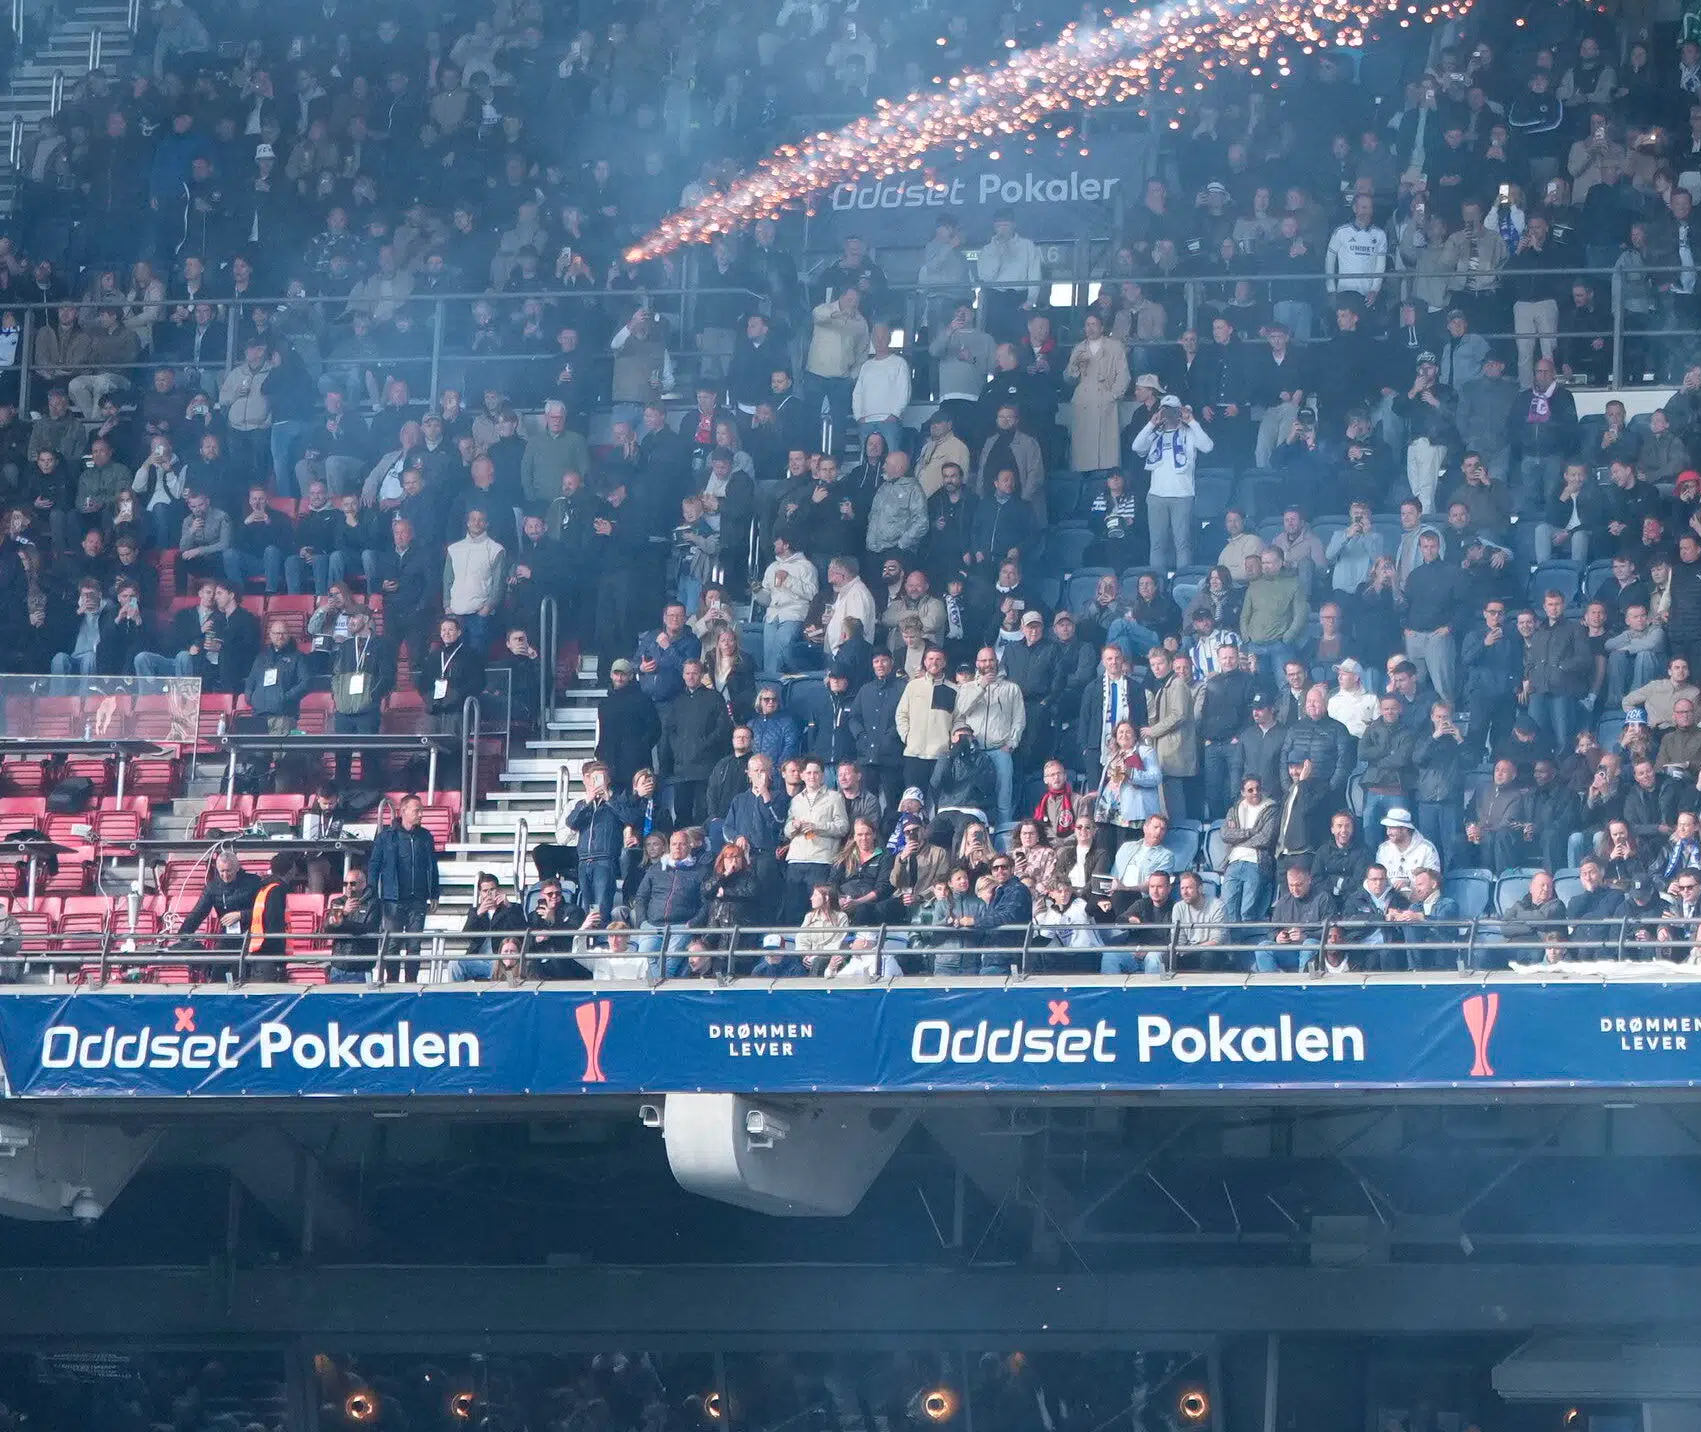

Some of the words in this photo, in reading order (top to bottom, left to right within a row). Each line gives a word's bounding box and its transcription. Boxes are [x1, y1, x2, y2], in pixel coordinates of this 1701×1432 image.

[832, 177, 966, 211] Oddset
[710, 1024, 813, 1039] DRØMMEN
[912, 1019, 1116, 1063] Oddset
[1138, 1014, 1365, 1062] Pokalen
[1622, 1035, 1687, 1050] LEVER
[42, 1024, 241, 1069] Oddset
[260, 1021, 480, 1068] Pokalen
[730, 1042, 793, 1056] LEVER
